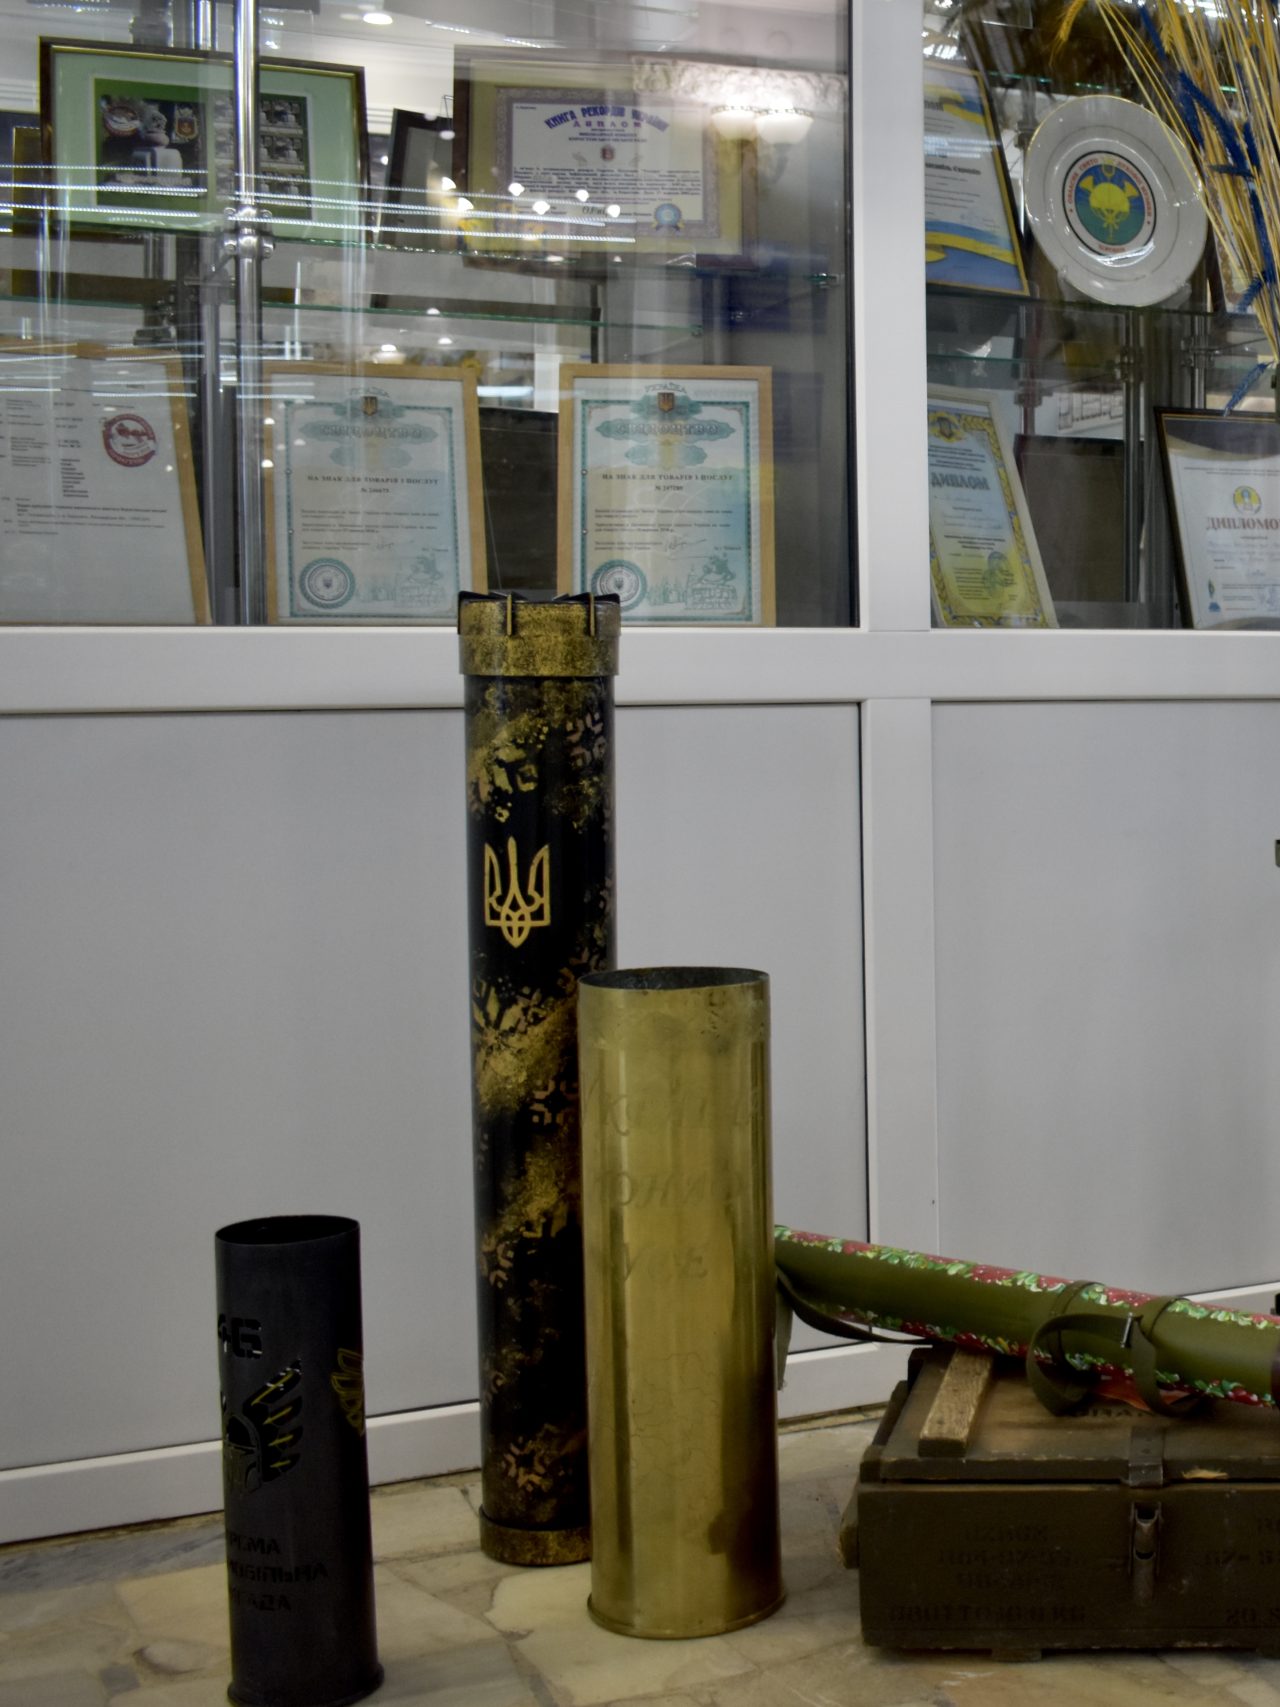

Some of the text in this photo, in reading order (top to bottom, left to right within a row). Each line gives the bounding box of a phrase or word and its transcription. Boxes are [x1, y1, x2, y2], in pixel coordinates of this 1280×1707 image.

[544, 110, 577, 130] КНИГА
[932, 472, 990, 490] ДИПЛОМ
[890, 1604, 991, 1622] BRUTTO
